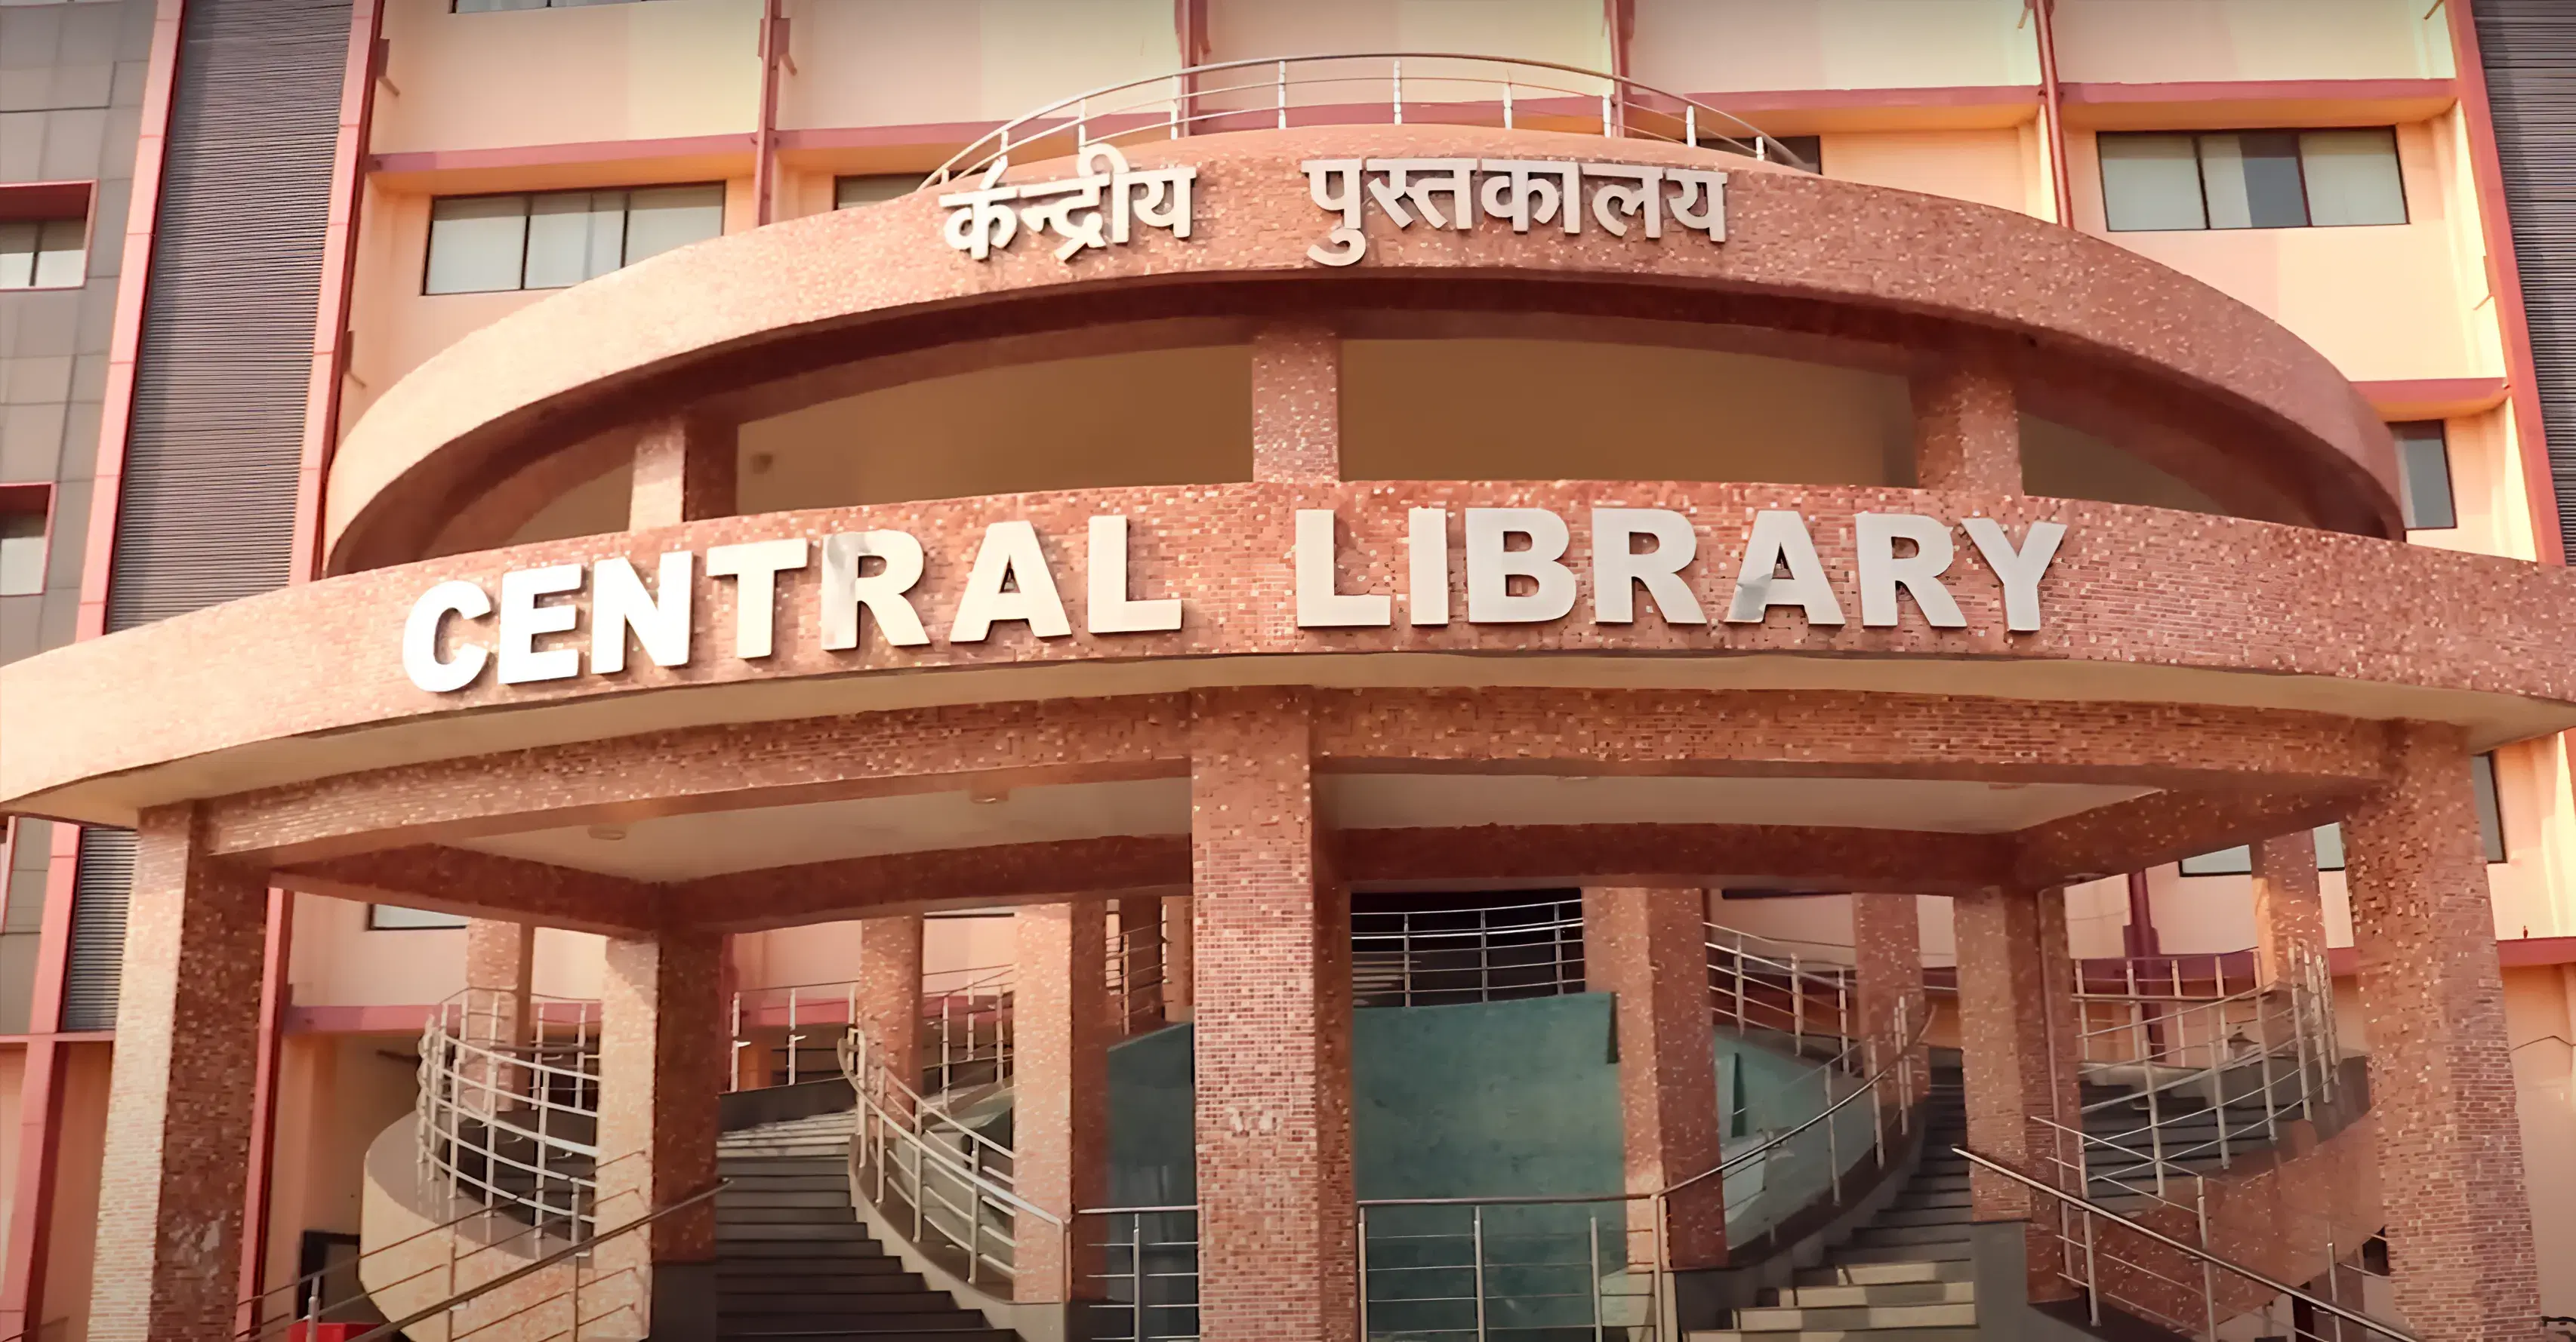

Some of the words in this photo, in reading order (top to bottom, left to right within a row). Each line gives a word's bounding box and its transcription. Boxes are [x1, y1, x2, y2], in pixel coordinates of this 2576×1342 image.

[938, 143, 1197, 262] केन्द्रीय
[1301, 158, 1728, 266] पुस्तकालय
[402, 514, 1182, 692] CENTRAL
[1295, 506, 2067, 632] LIBRARY
